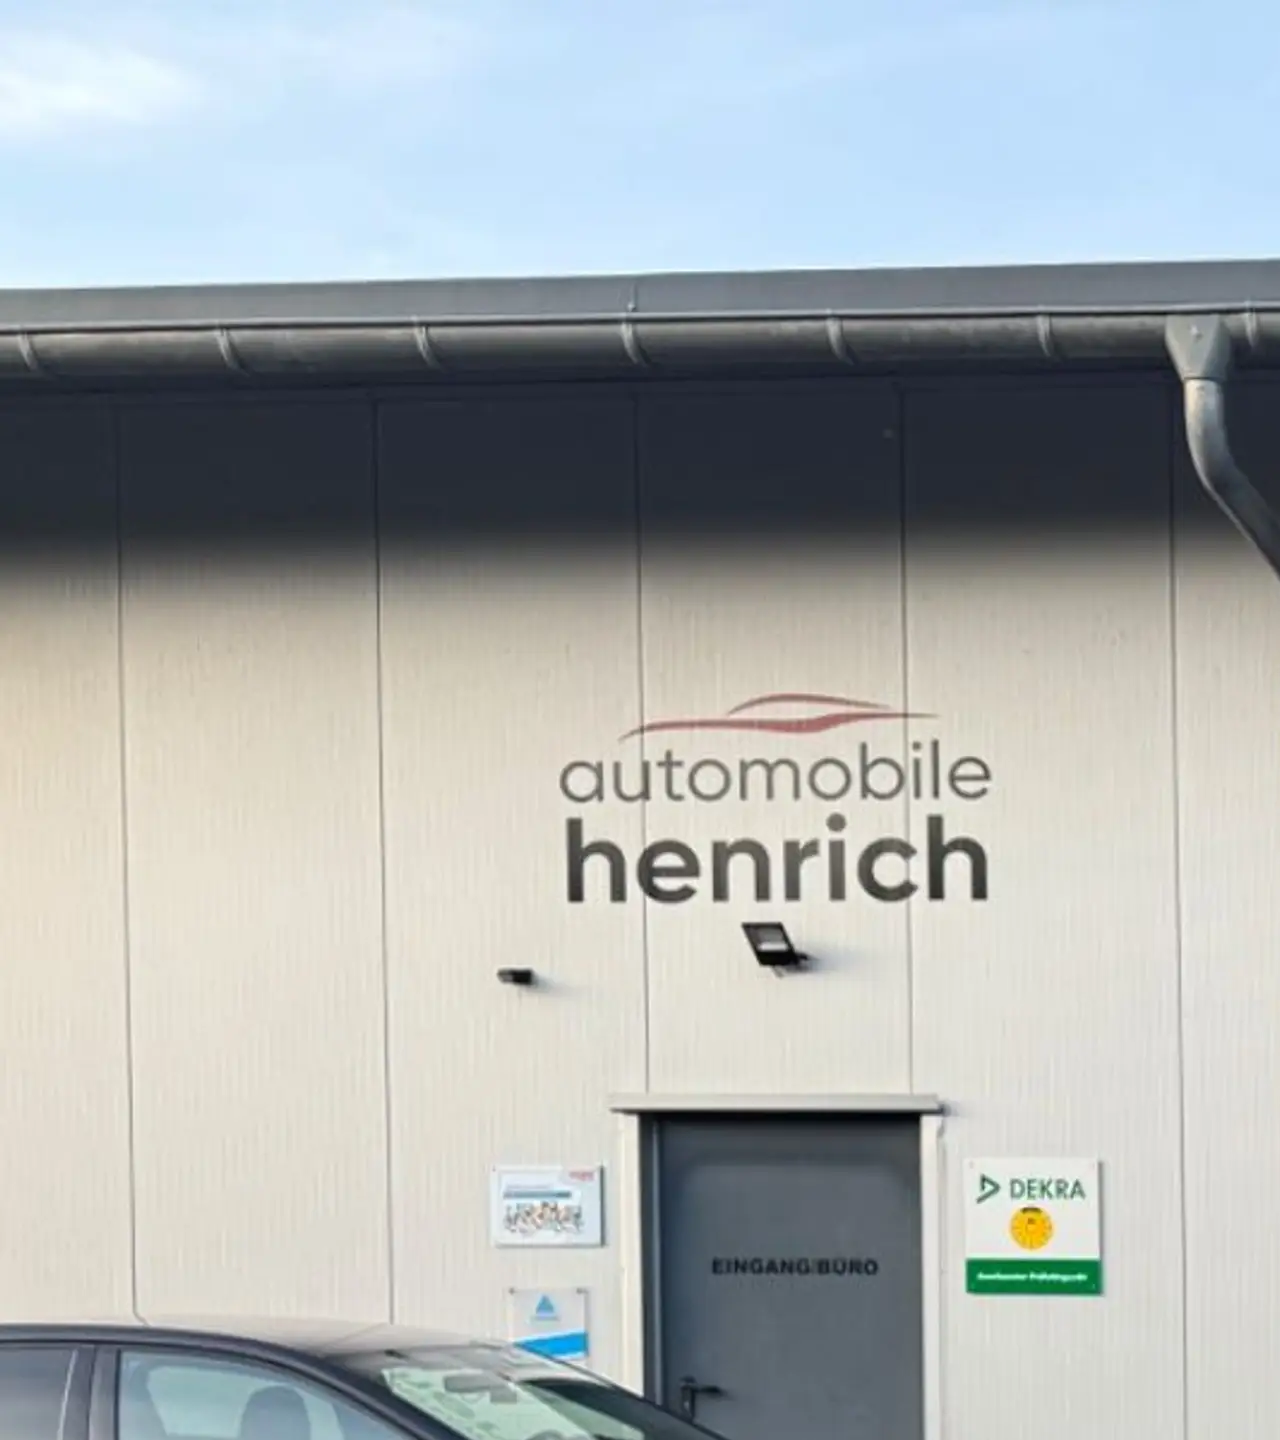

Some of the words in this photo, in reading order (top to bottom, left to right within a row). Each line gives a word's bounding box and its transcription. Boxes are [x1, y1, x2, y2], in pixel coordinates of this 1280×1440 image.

[559, 738, 992, 802] automobile
[565, 812, 989, 904] henrich
[1009, 1177, 1087, 1201] DEKRA
